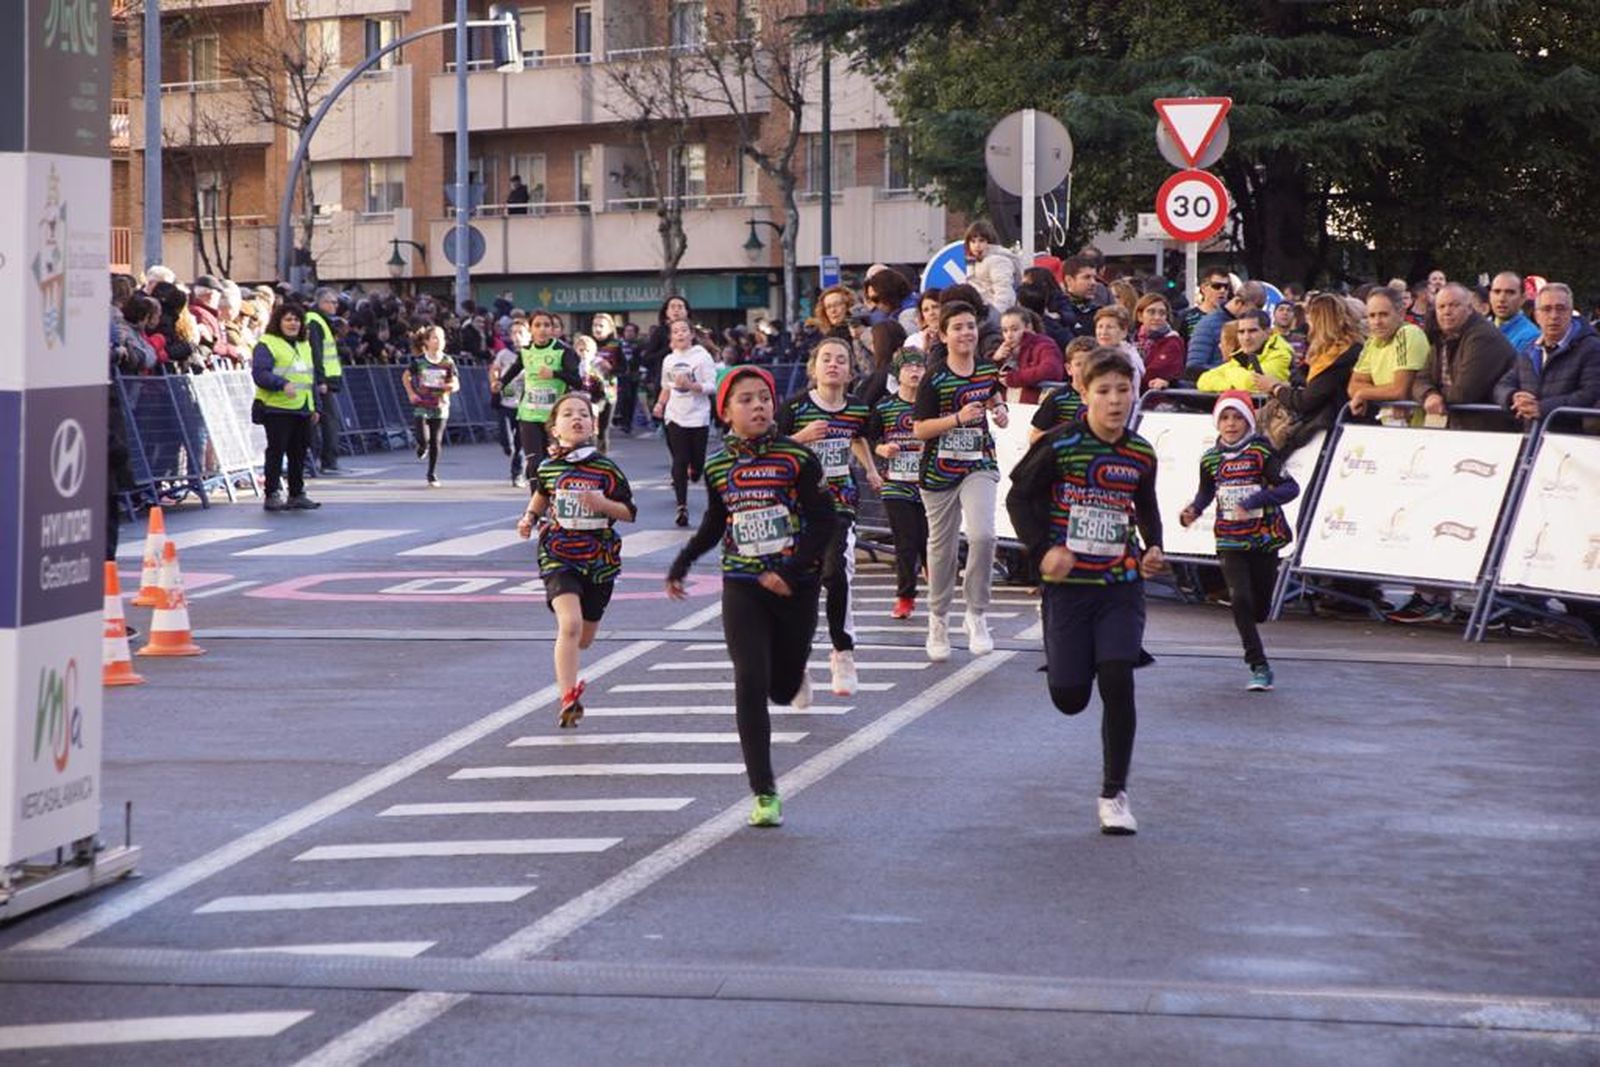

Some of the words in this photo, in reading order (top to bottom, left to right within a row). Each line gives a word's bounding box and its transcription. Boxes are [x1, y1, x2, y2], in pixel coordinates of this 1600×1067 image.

[1173, 195, 1212, 219] 30
[944, 436, 975, 450] 5839
[893, 459, 920, 472] 5873
[41, 508, 92, 548] HYUNDAI
[739, 520, 777, 541] 5884
[1077, 519, 1116, 540] 5805
